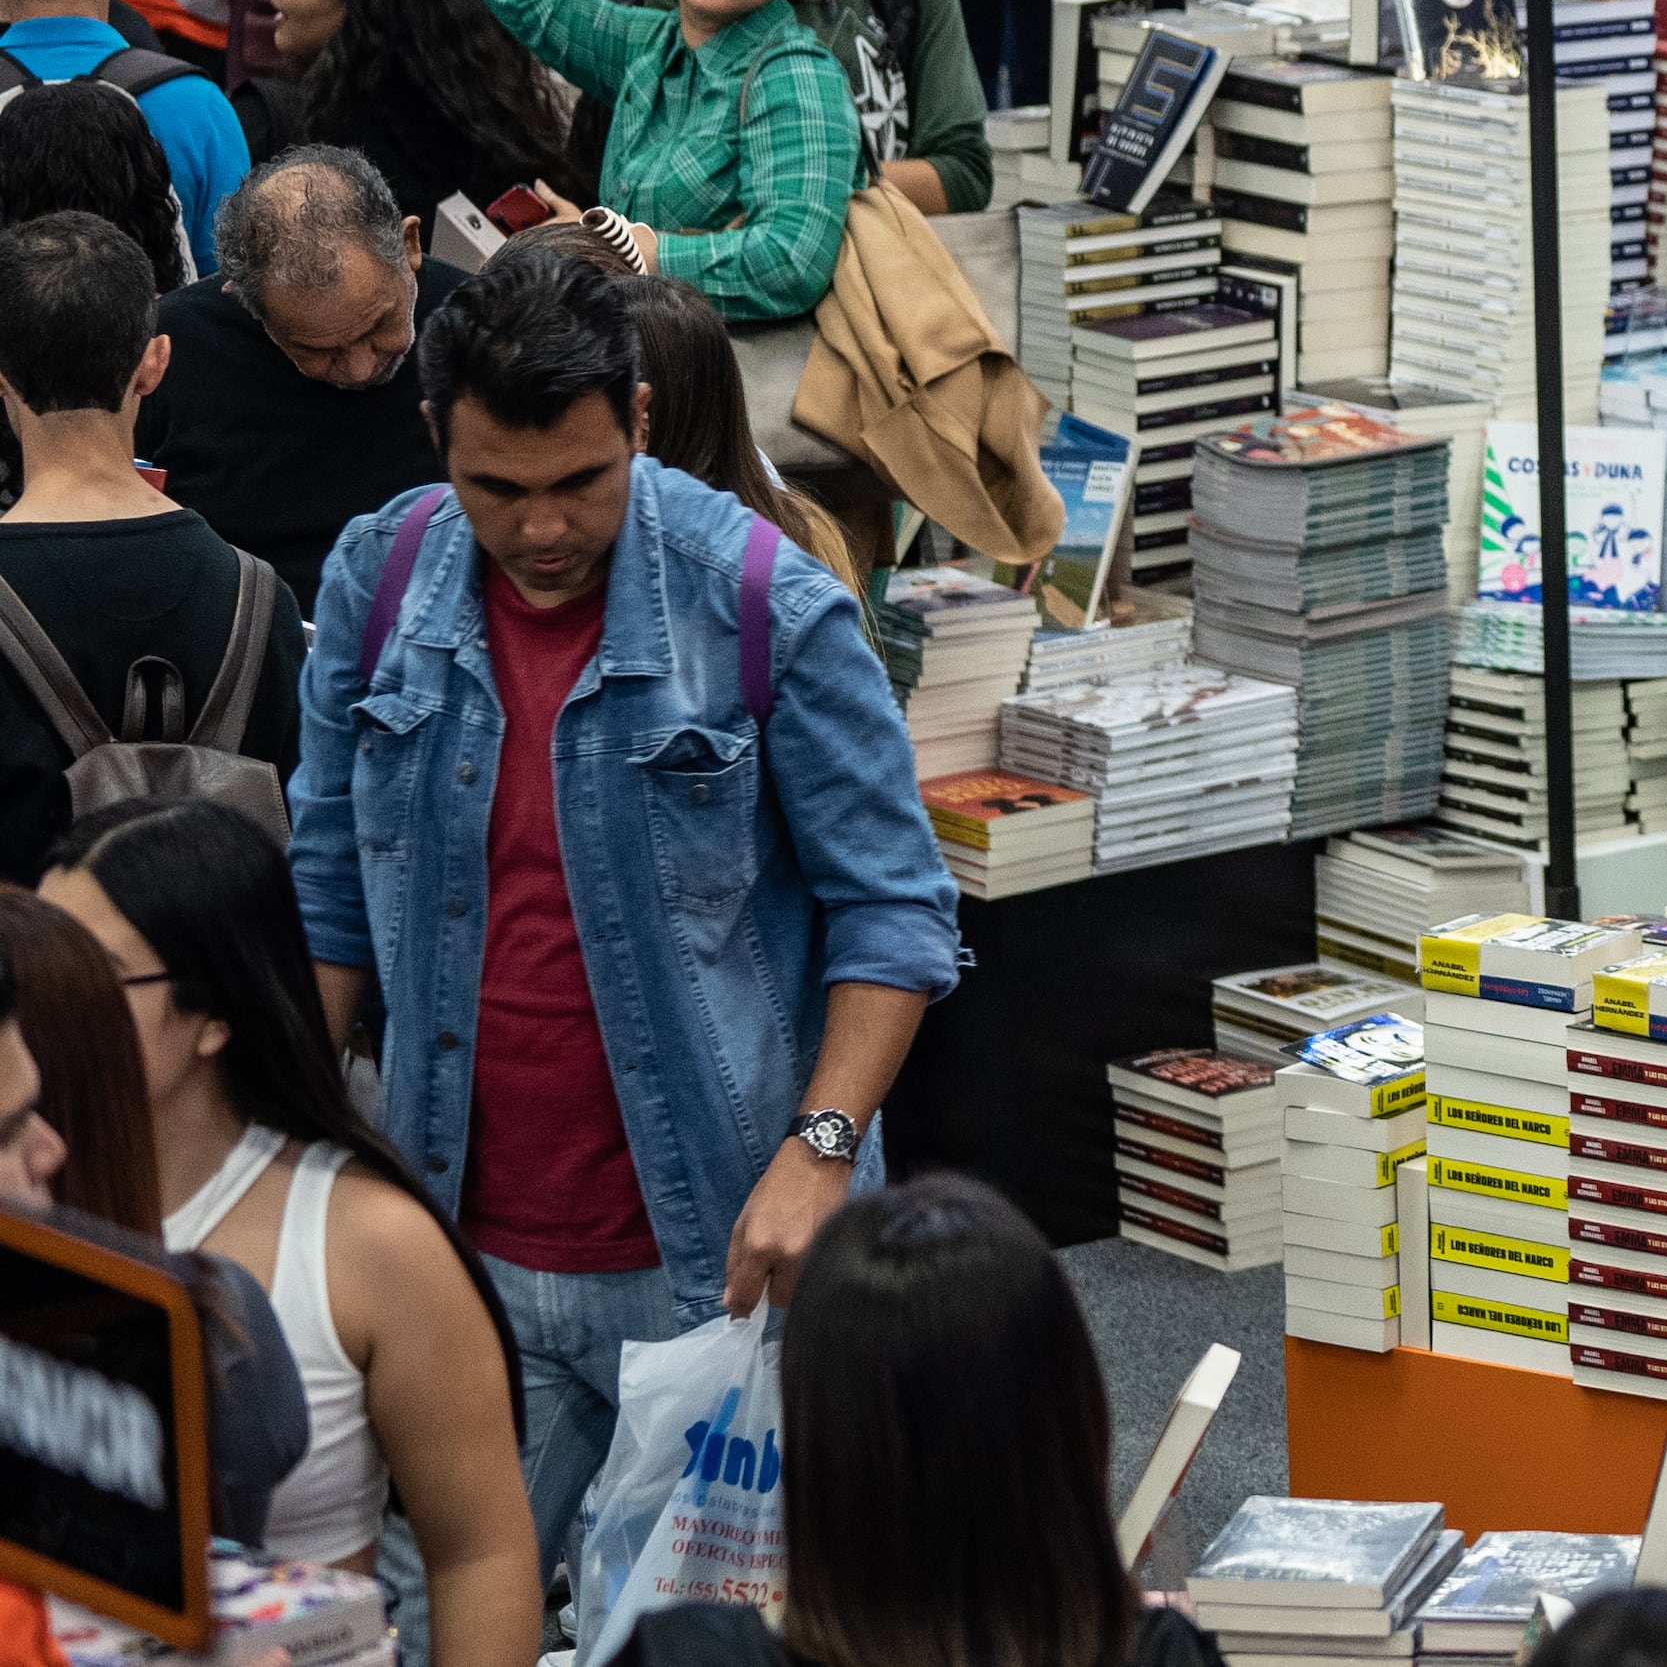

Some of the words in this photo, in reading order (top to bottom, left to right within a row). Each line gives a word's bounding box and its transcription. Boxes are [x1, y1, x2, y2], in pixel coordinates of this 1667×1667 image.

[1595, 463, 1642, 479] DUNA
[1431, 959, 1467, 972] ANABEL
[1604, 998, 1637, 1009] ANABEL
[1612, 1061, 1644, 1080] EMMA
[1447, 1107, 1464, 1120] LOS
[1465, 1107, 1504, 1130] SEÑORES
[1505, 1115, 1521, 1131] DEL
[1522, 1118, 1551, 1136] NARCO
[1447, 1168, 1463, 1182] LOS
[1464, 1168, 1503, 1191] SEÑORES
[1505, 1177, 1520, 1193] DEL
[1521, 1180, 1551, 1198] NARCO
[1451, 1238, 1466, 1252] LOS
[1468, 1238, 1506, 1261] SEÑORES
[1508, 1248, 1524, 1264] DEL
[1525, 1250, 1554, 1268] NARCO
[1457, 1304, 1486, 1320] NARCO
[1487, 1307, 1502, 1323] DEL
[1545, 1319, 1561, 1334] LOS
[674, 1540, 745, 1566] OFERTAS
